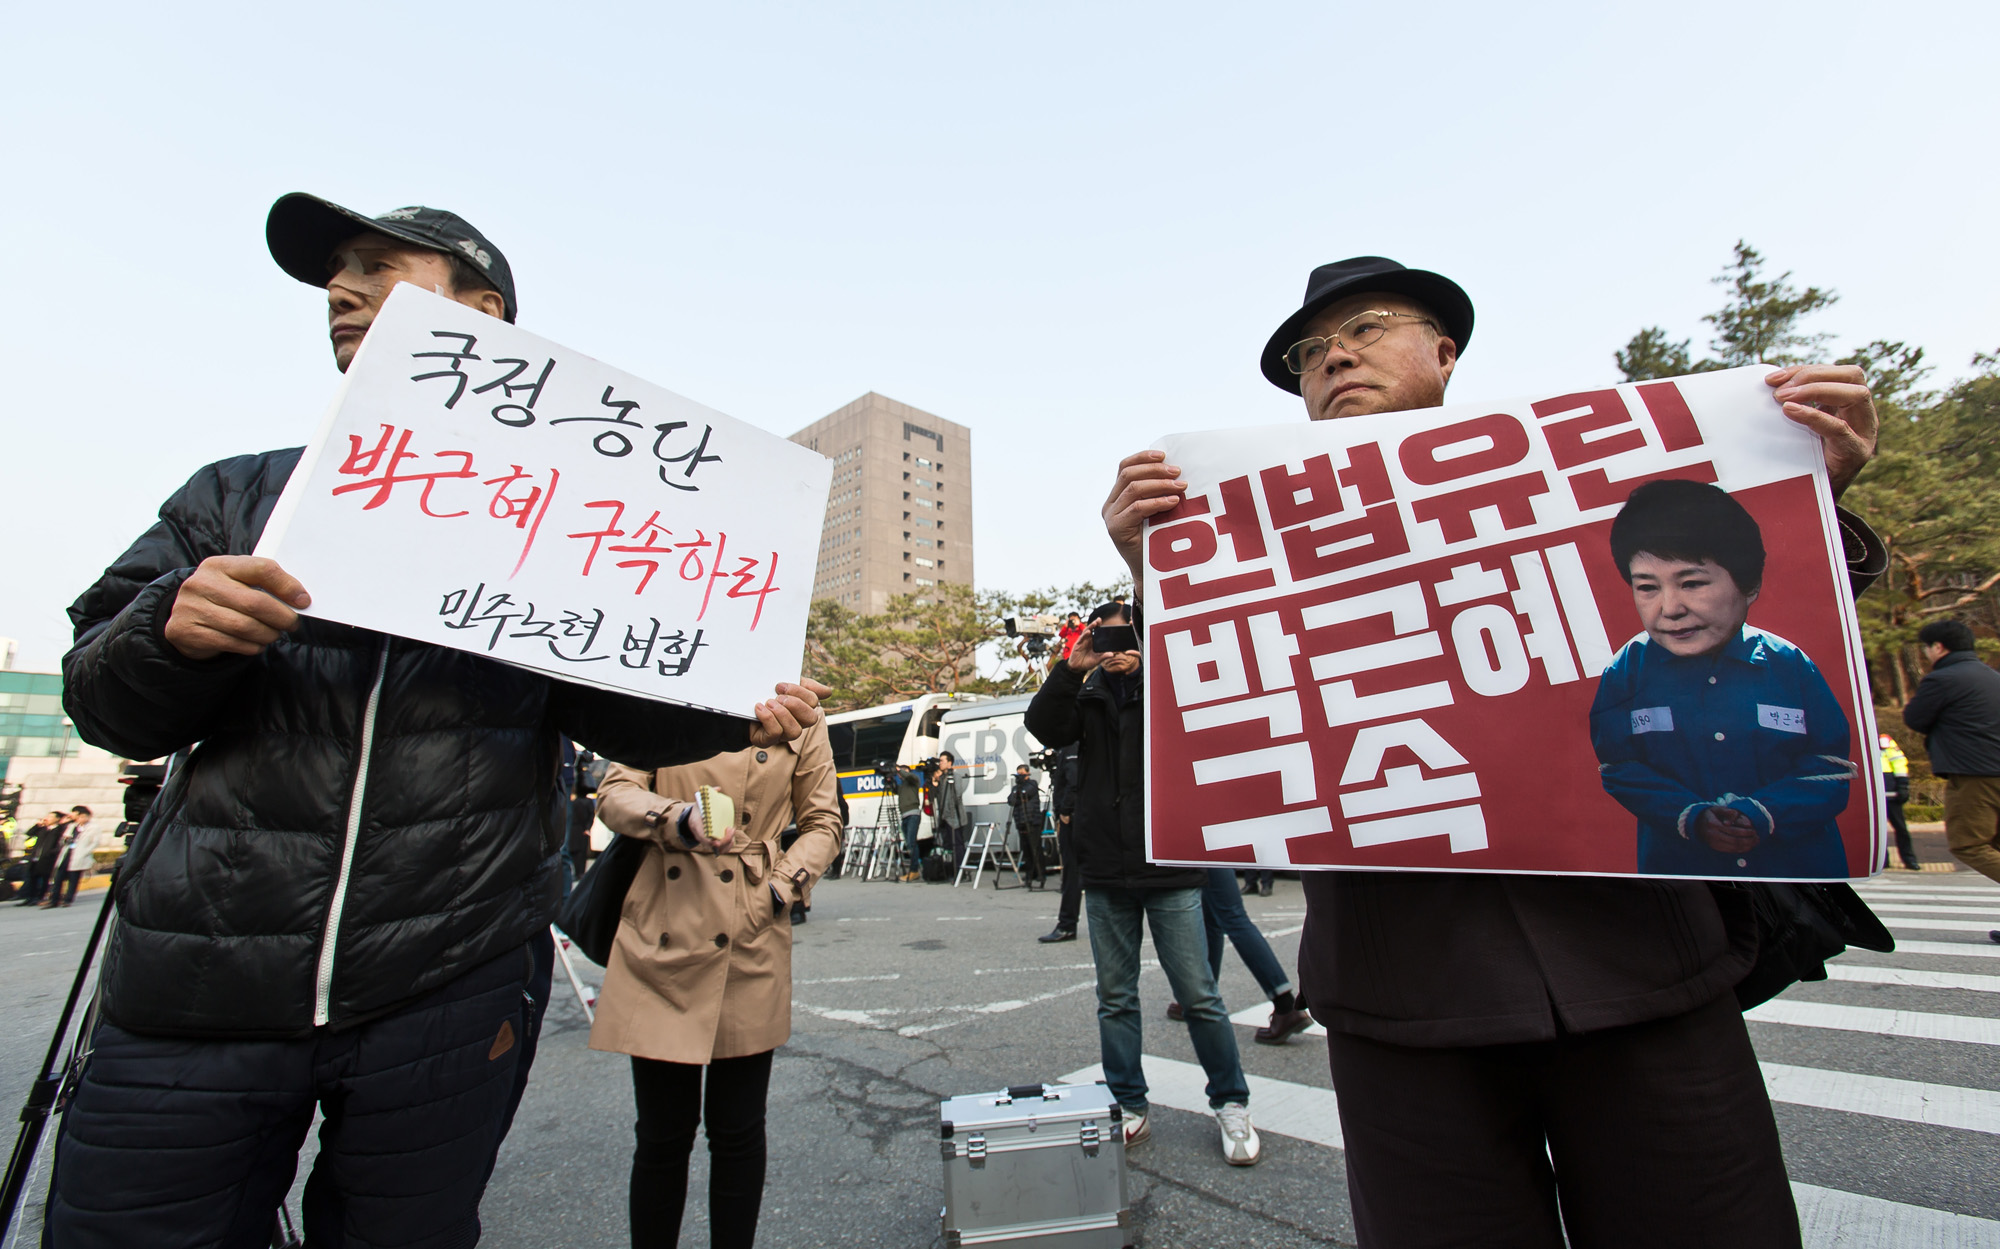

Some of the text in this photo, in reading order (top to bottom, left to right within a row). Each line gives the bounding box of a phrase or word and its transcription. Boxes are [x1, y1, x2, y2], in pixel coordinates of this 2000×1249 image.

[411, 331, 723, 491] 국정 농단
[332, 423, 780, 632] 박근혜 구속하라
[1148, 381, 1719, 610] 헌법유린
[439, 582, 610, 661] 민주노련
[1164, 543, 1612, 739] 박근혜
[857, 776, 886, 791] POLIC
[1192, 719, 1489, 864] 구속
